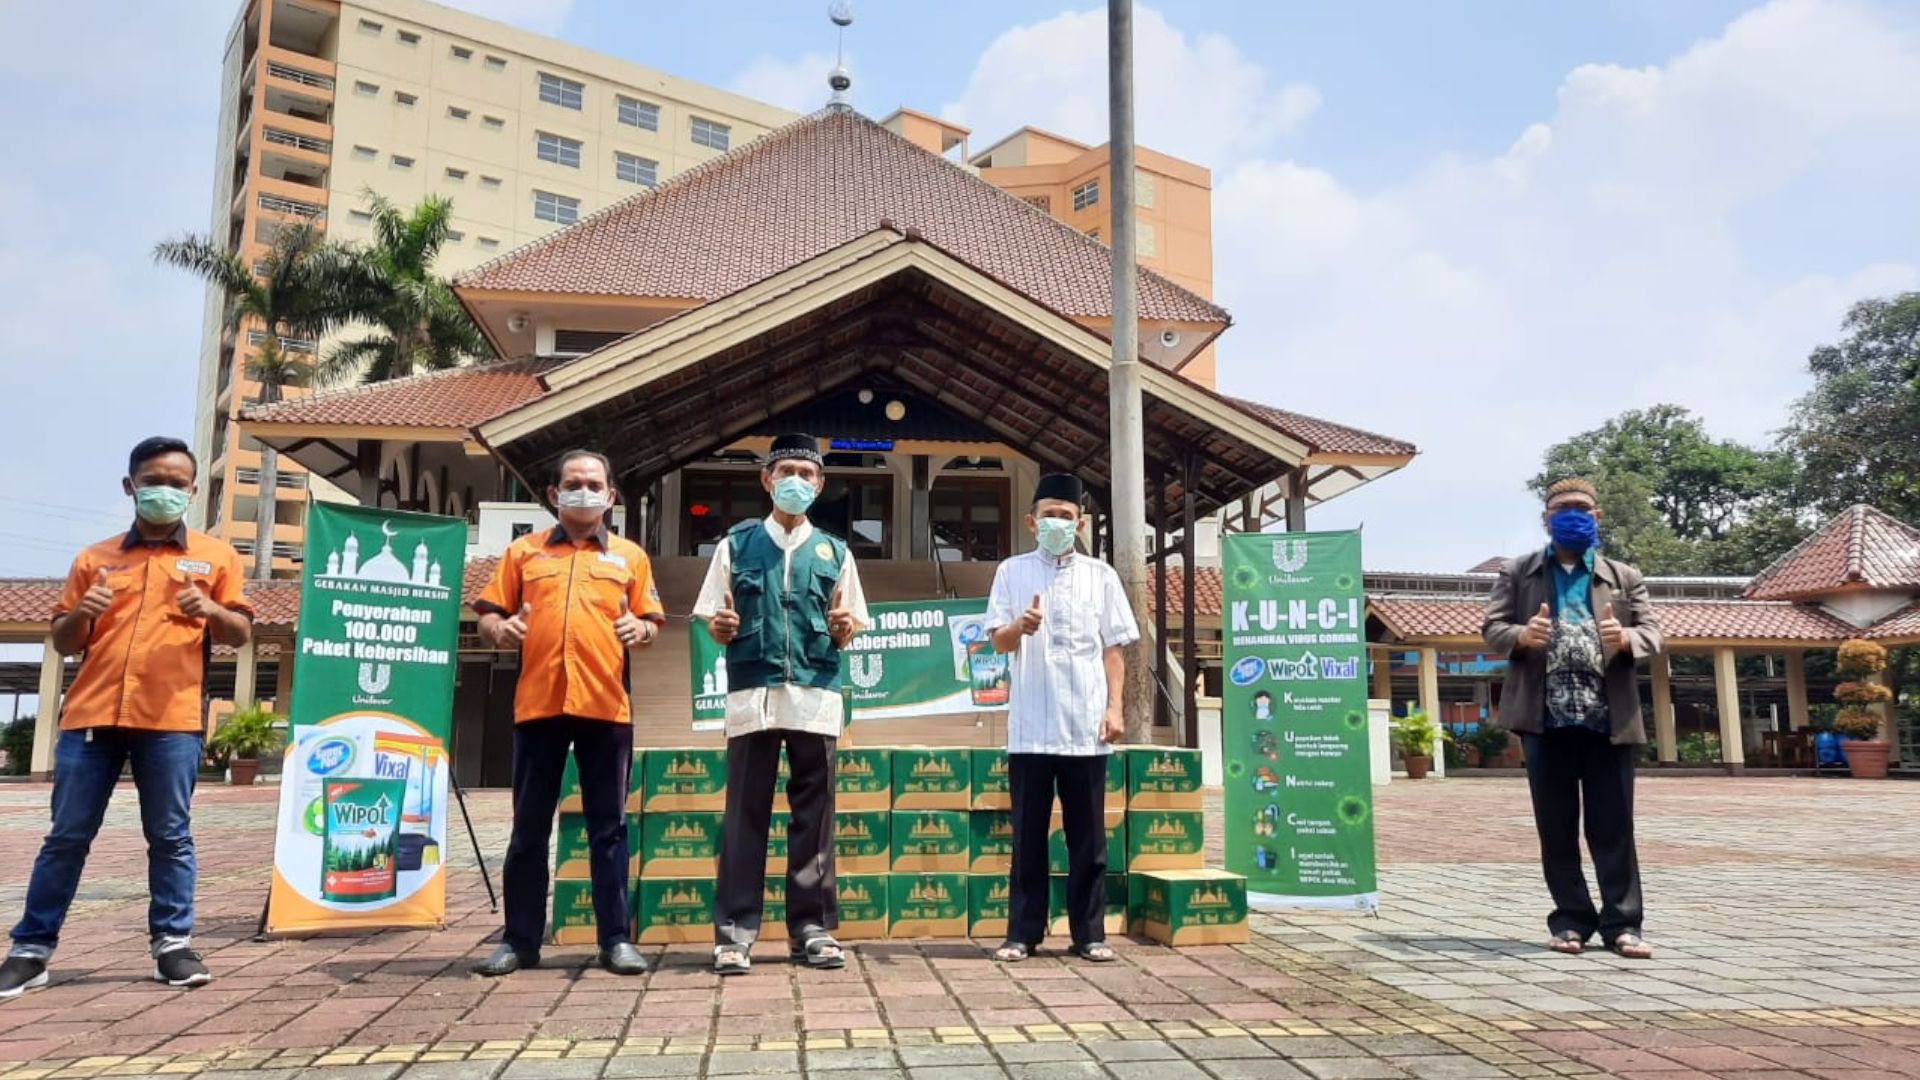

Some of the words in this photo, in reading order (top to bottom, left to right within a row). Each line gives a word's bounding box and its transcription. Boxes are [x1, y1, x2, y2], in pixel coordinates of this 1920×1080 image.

[314, 579, 366, 593] GERAKAN
[369, 585, 409, 598] MASJID
[412, 588, 449, 600] BERSIH
[332, 600, 432, 624] Penyerahan
[879, 609, 944, 630] 100.000
[1231, 598, 1359, 631] K-U-N-C-I
[344, 621, 417, 643] 100.000
[302, 637, 350, 657] Paket
[353, 642, 449, 665] Kebersihan
[1269, 655, 1318, 679] WIPOL
[1321, 657, 1358, 679] Vixal
[352, 695, 393, 705] Unilever
[375, 753, 410, 778] Vixal
[334, 796, 388, 825] WIPOL
